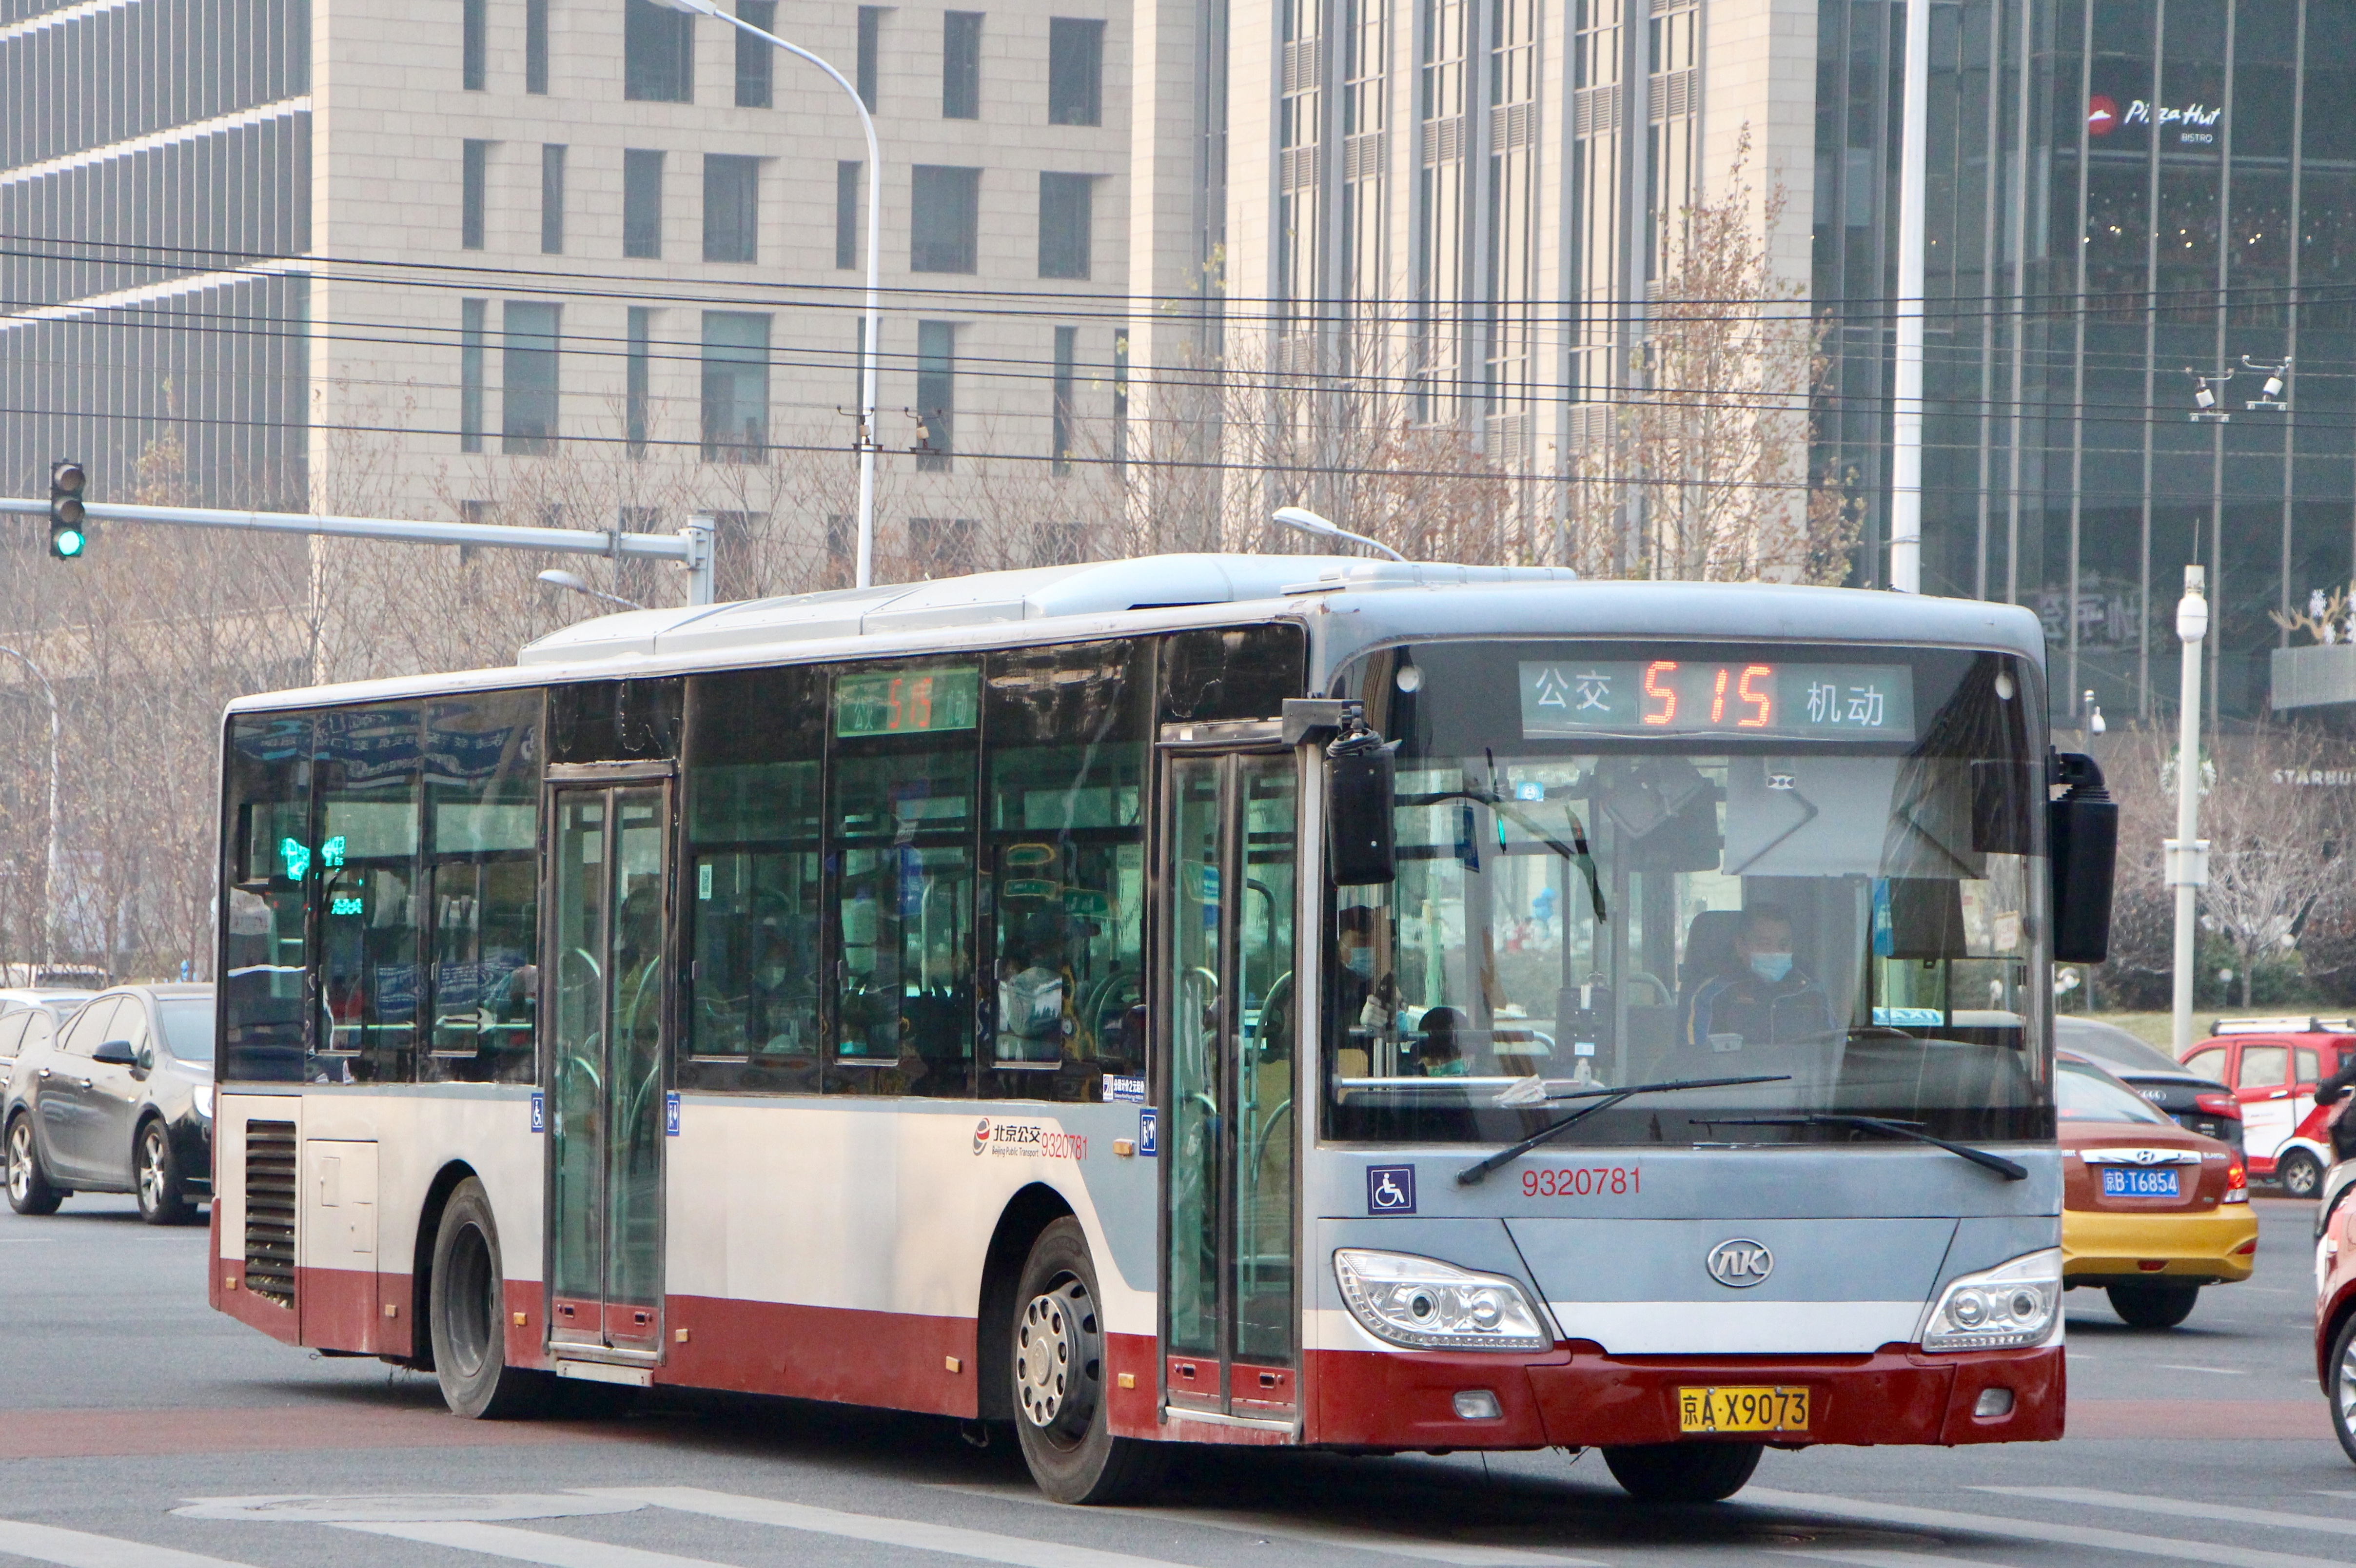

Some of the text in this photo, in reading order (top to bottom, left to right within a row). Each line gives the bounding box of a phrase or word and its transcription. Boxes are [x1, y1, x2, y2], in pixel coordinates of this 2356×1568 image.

[2123, 100, 2221, 125] Piza Hut
[2180, 133, 2213, 143] BISTRO
[1534, 661, 1885, 727] 公交 515 机动
[992, 1146, 1039, 1158] Beijing Public Transport
[993, 1124, 1088, 1160] 北京公交 9320781
[1522, 1167, 1639, 1197] 9320781
